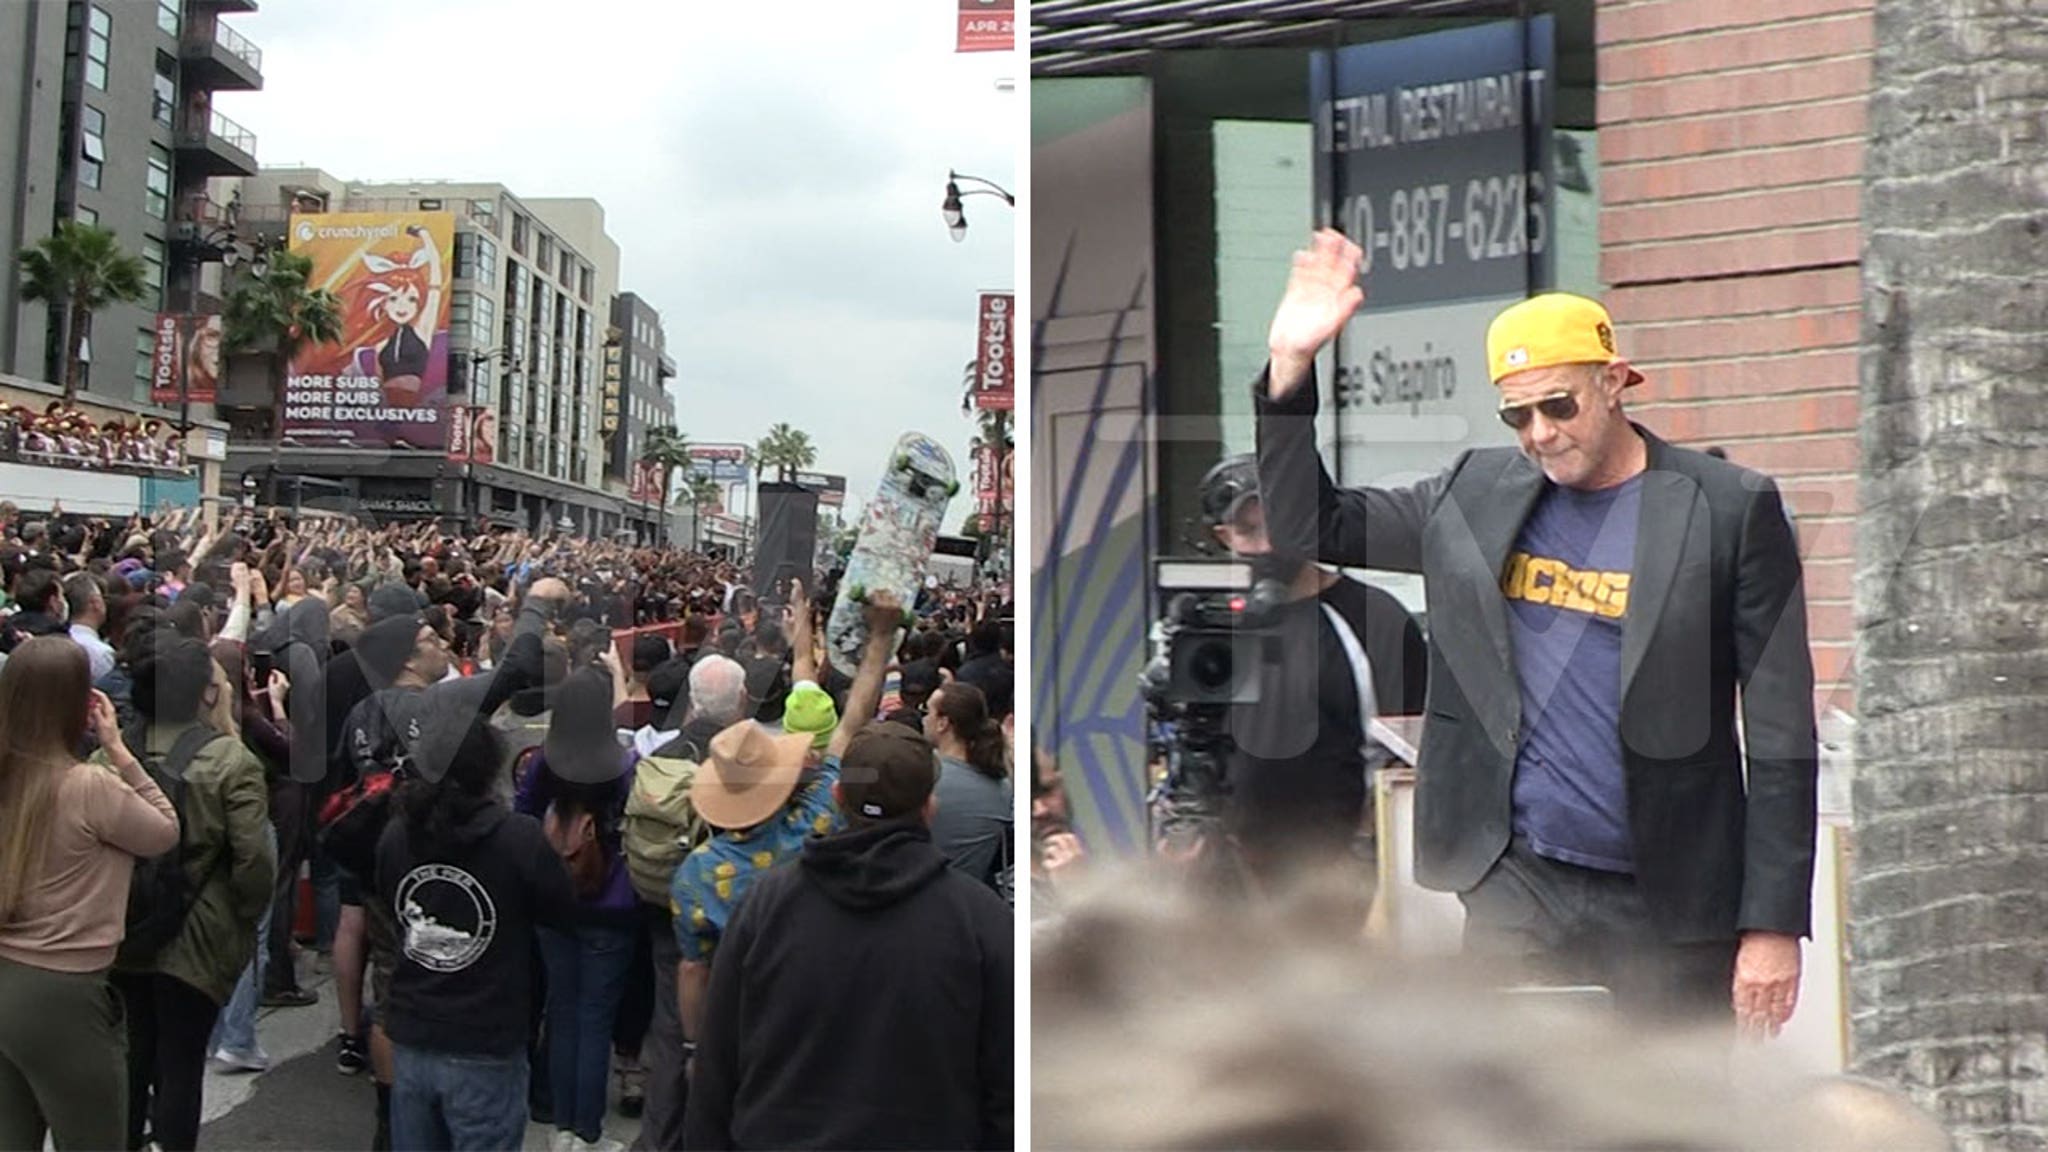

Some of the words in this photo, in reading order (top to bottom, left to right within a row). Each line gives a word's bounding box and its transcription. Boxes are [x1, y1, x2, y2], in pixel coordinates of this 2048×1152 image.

[964, 20, 998, 32] APR
[1000, 20, 1015, 32] 2
[981, 298, 1007, 390] Tootsie
[156, 318, 175, 388] Tootsie
[286, 375, 333, 388] MORE
[335, 375, 380, 389] SUBS
[1371, 342, 1456, 418] Shapiro
[286, 391, 333, 404] MORE
[334, 391, 380, 405] DUBS
[284, 406, 332, 420] MORE
[333, 407, 438, 423] EXCLUSIVES
